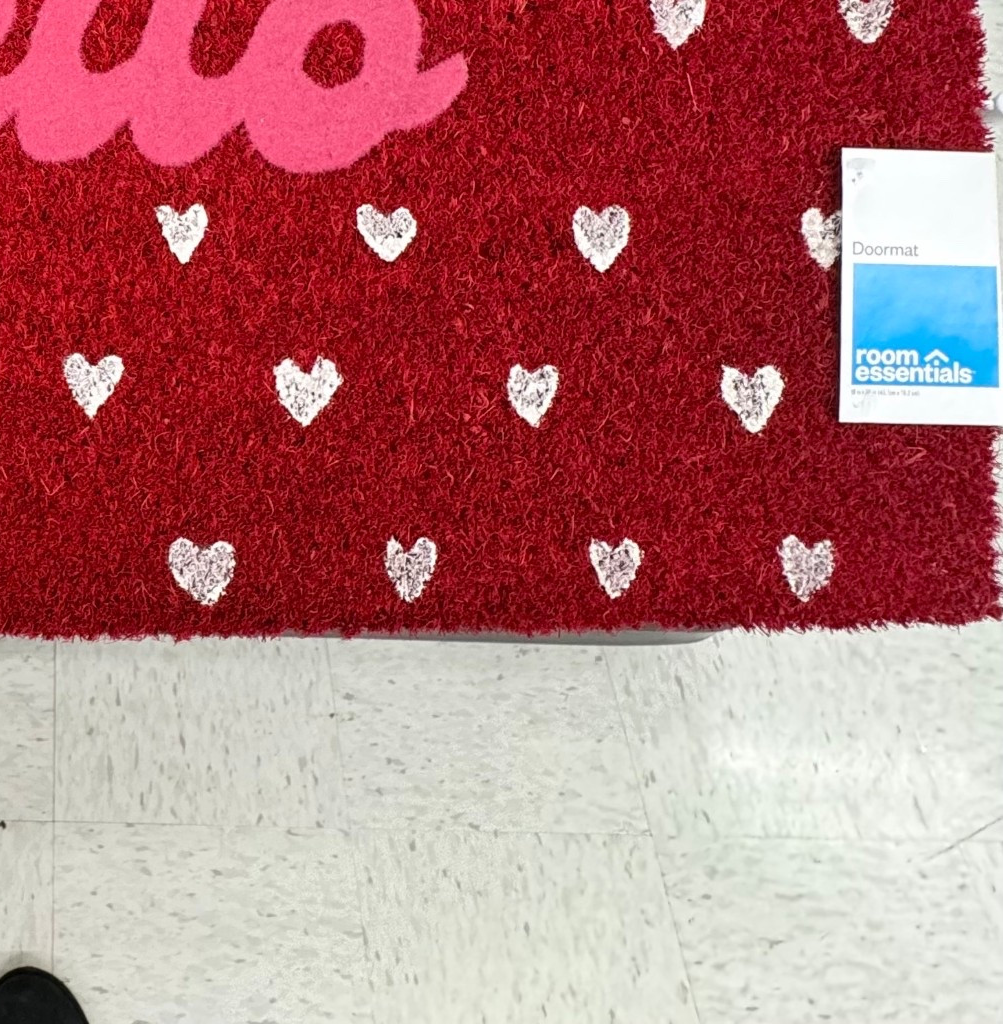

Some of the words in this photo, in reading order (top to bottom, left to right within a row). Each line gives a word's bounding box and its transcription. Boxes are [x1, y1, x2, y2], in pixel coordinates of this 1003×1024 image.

[852, 241, 919, 257] Doormat
[856, 348, 919, 365] room
[855, 361, 973, 384] essentials
